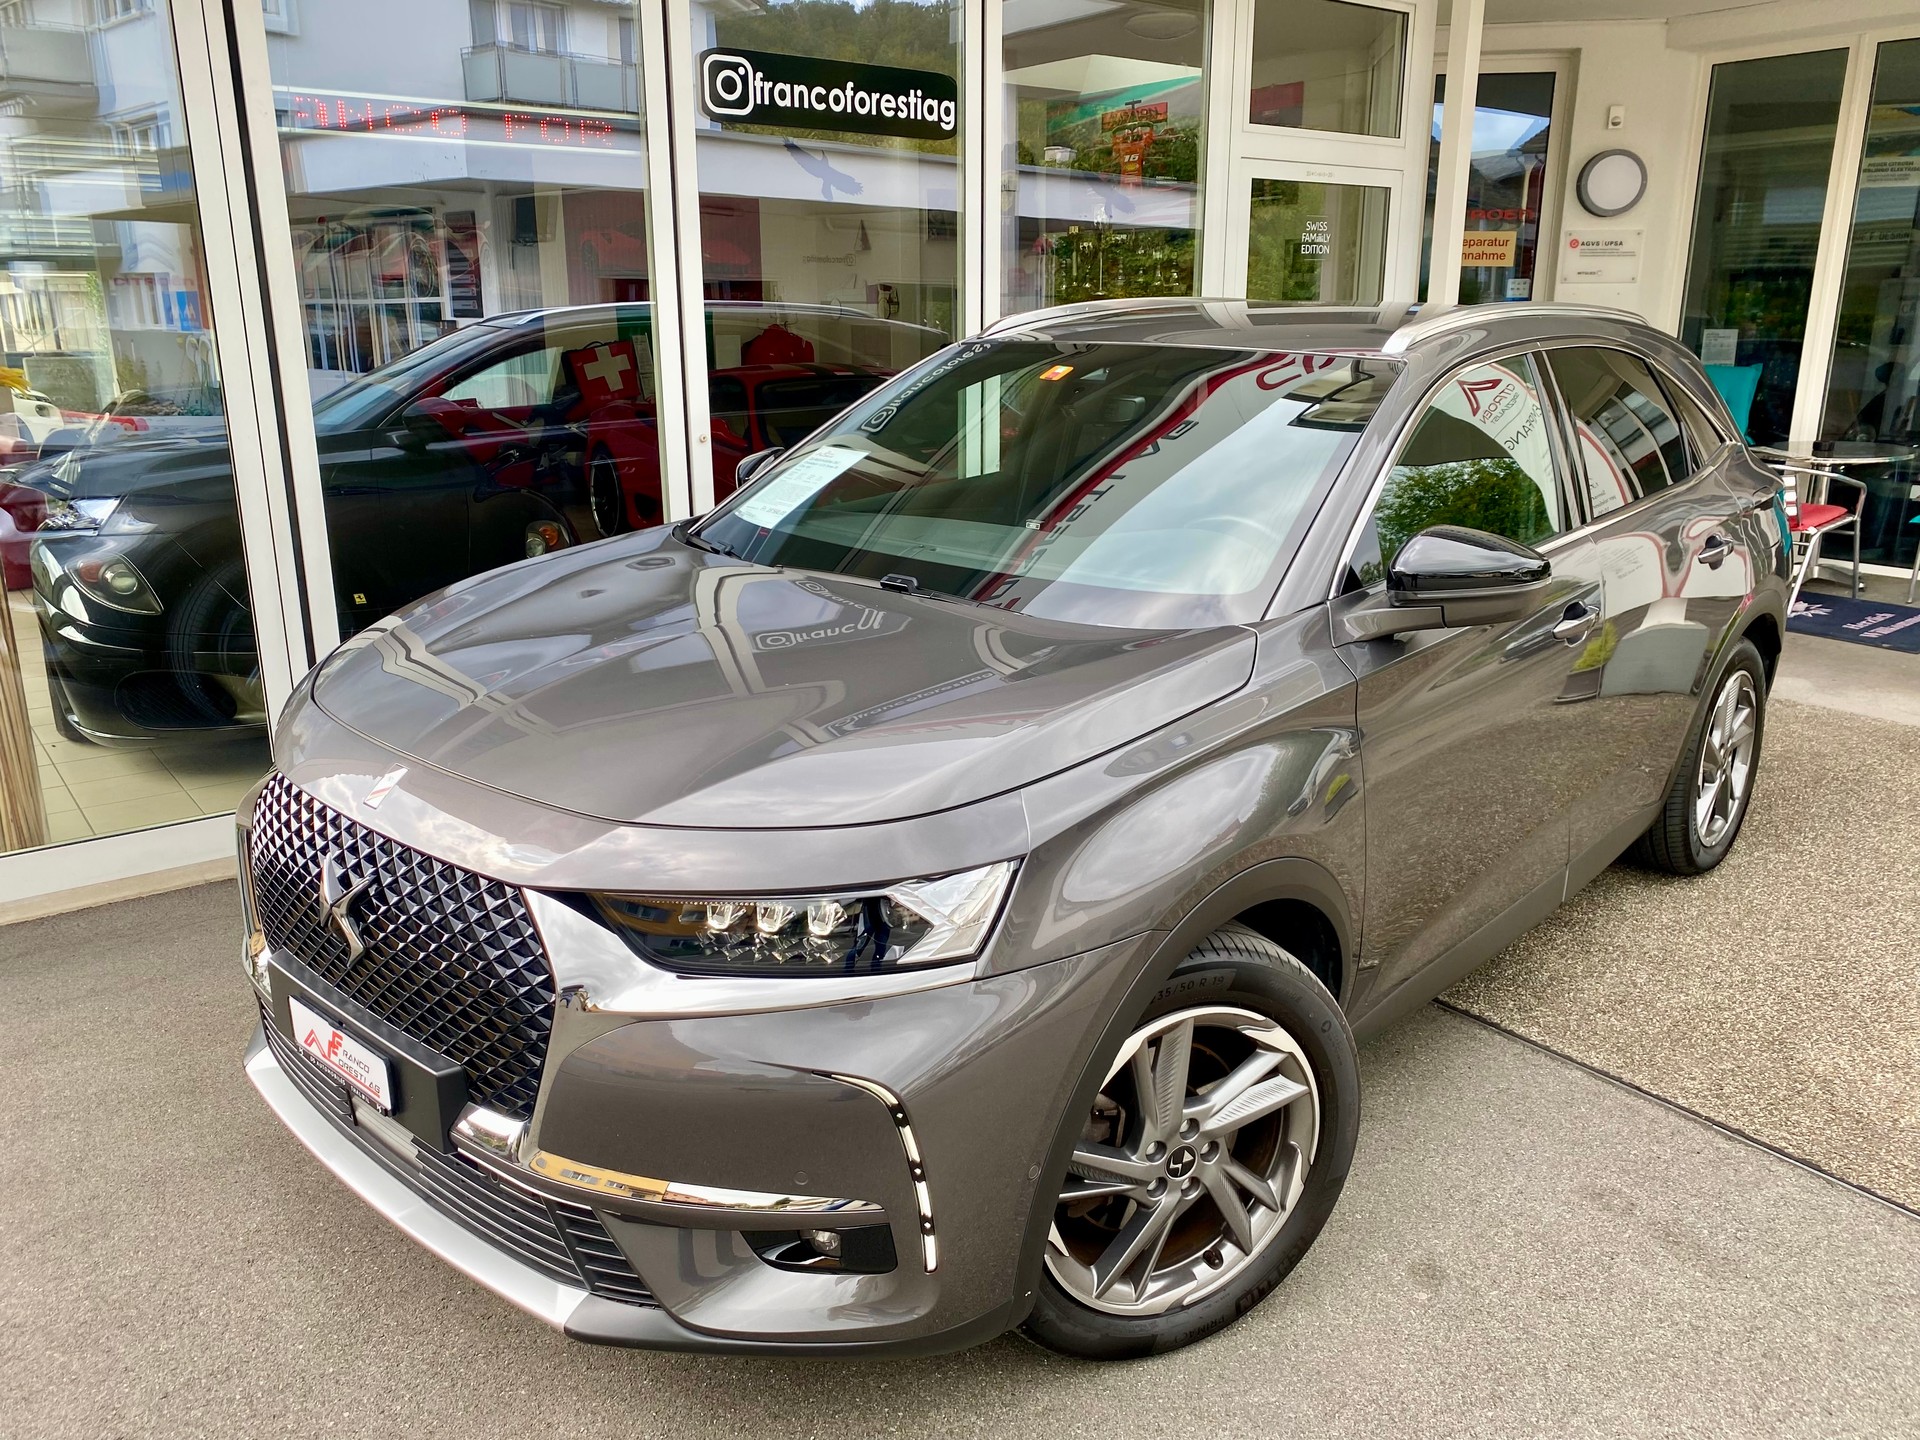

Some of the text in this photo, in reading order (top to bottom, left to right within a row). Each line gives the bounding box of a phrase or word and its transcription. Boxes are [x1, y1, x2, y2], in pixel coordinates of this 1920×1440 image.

[754, 71, 956, 131] francoforestiag
[1123, 153, 1140, 162] 16
[1305, 221, 1328, 232] SWISS
[1300, 244, 1330, 255] EDITION
